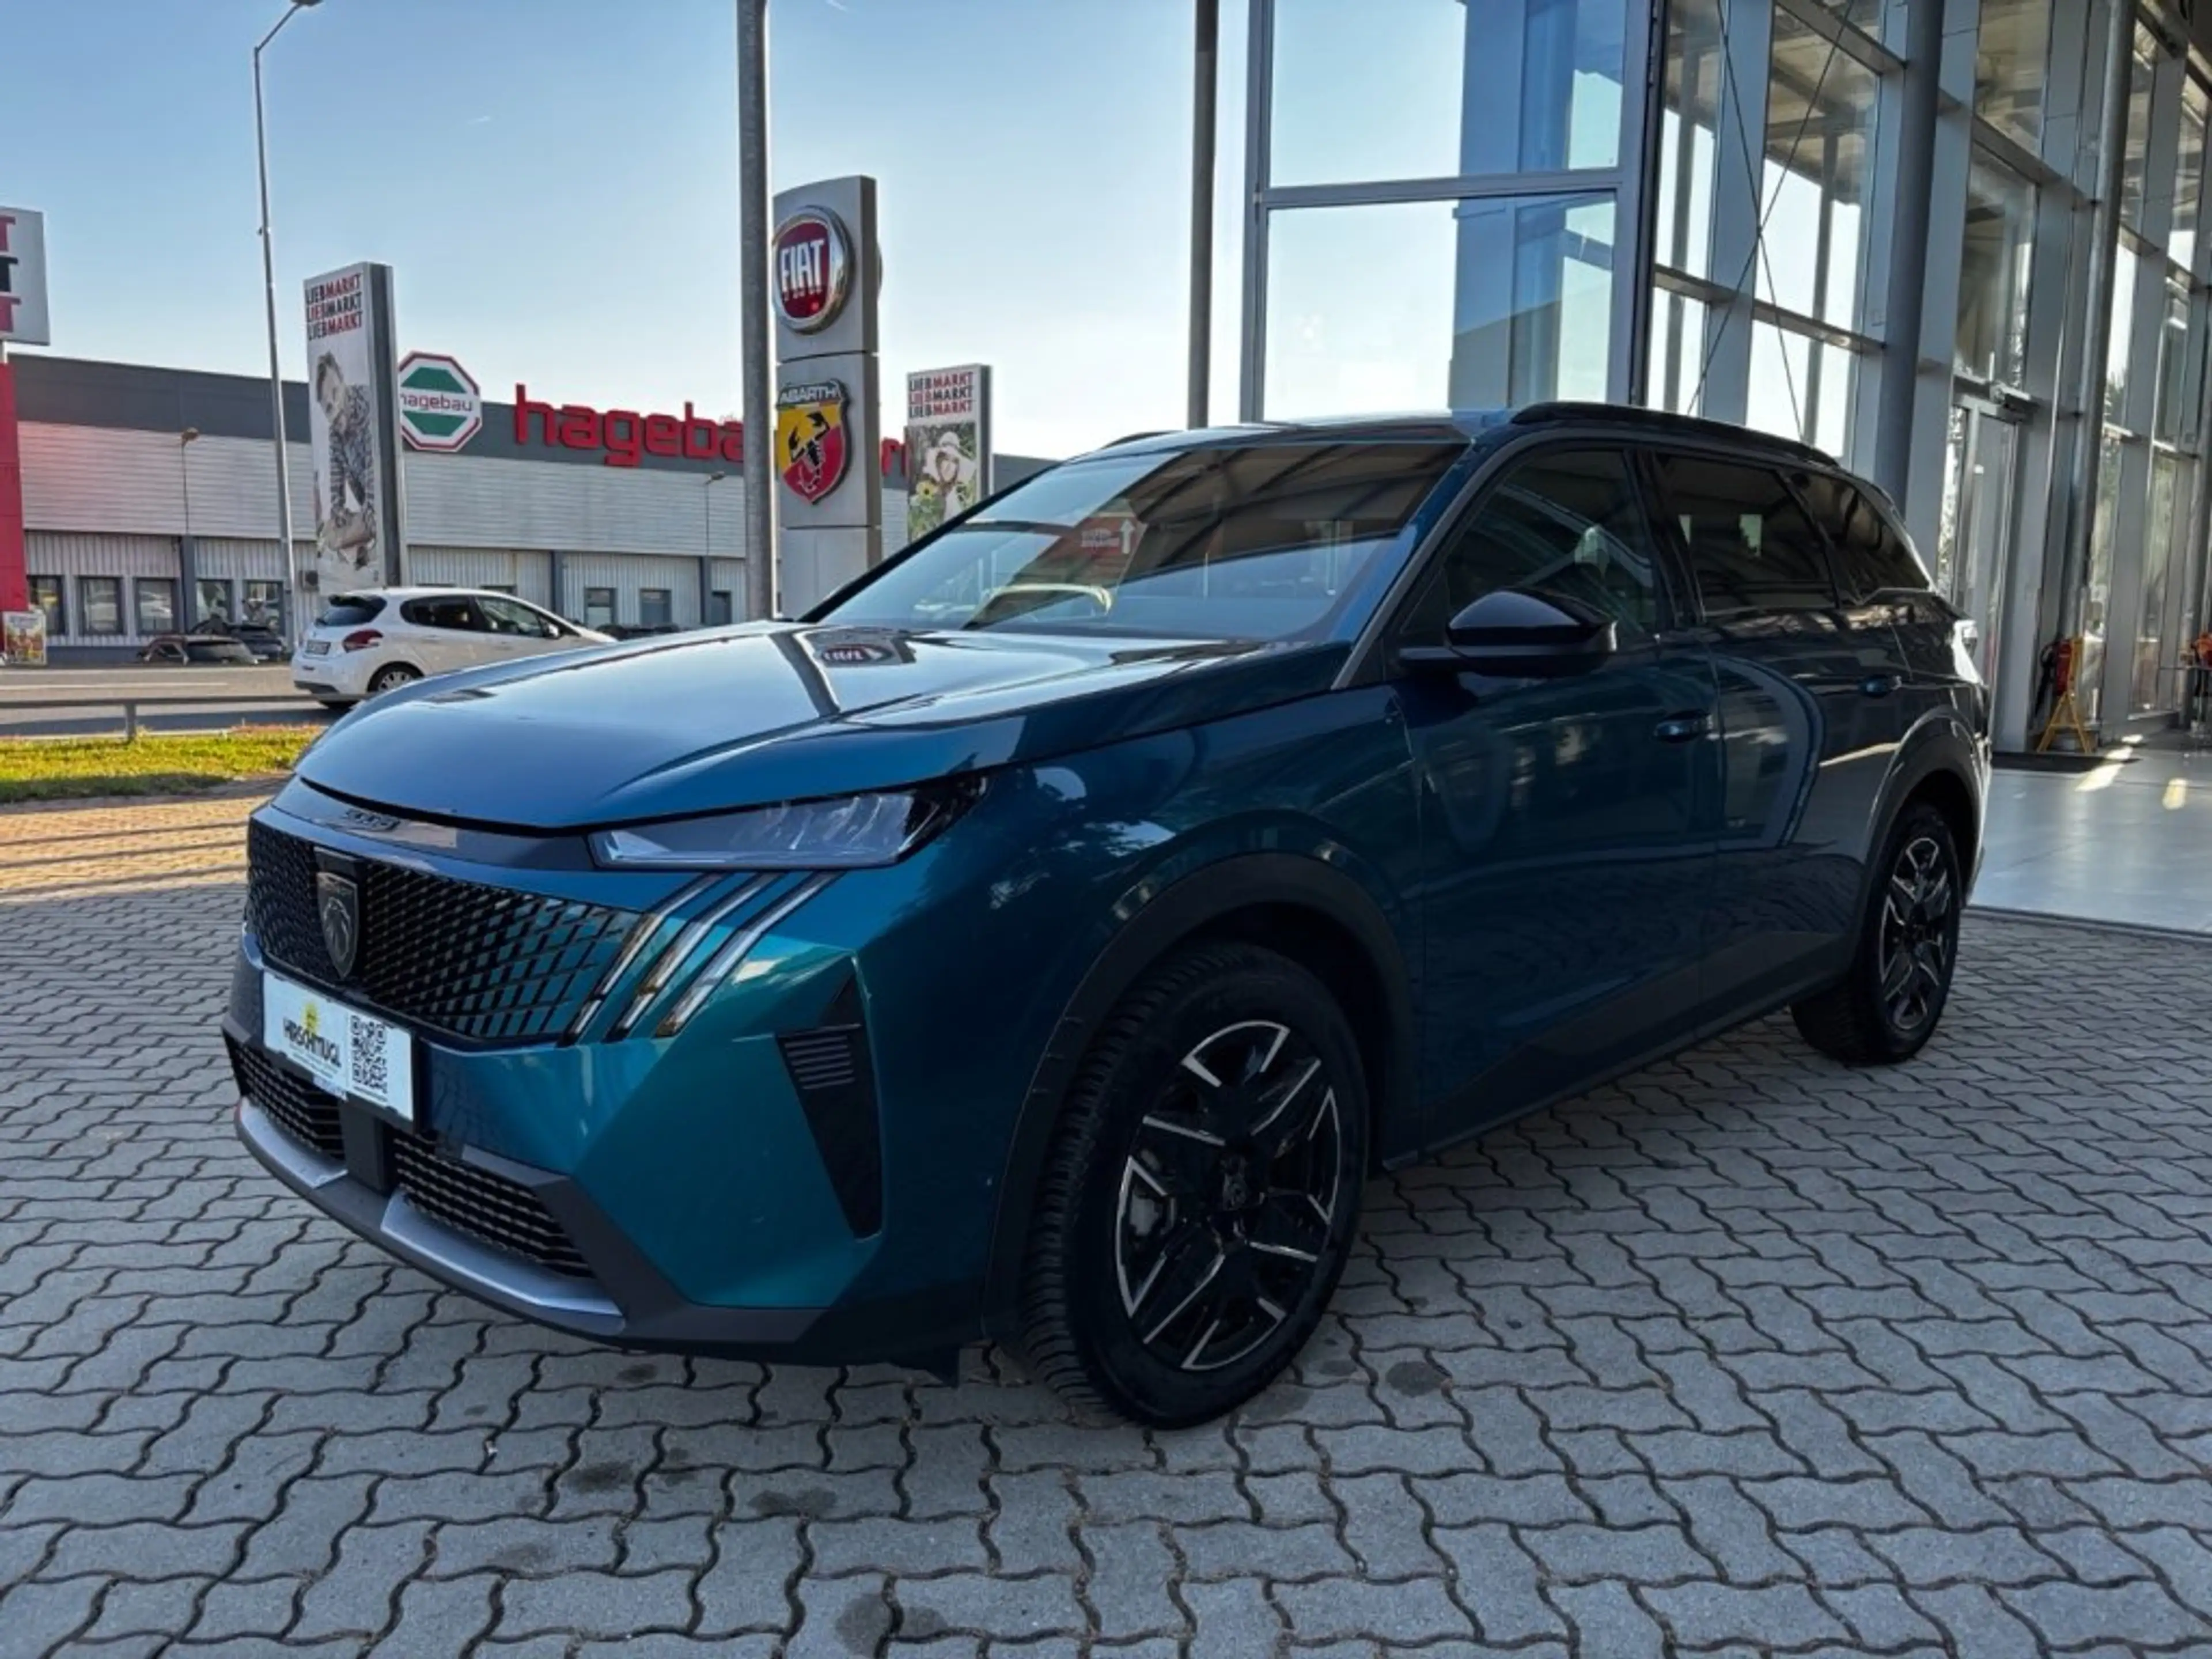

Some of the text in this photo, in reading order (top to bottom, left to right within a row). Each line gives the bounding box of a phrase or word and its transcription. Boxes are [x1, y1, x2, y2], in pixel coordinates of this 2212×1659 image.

[781, 238, 825, 293] FIAT
[305, 273, 361, 304] LIEBMARKT
[306, 291, 362, 323] LIEBMARKT
[308, 310, 363, 341] LIEBMARKT
[780, 386, 837, 403] ABARTH
[908, 372, 973, 392] LIEBMARKT
[908, 385, 974, 405] LIEBMARKT
[908, 400, 974, 418] LIEBMARKT
